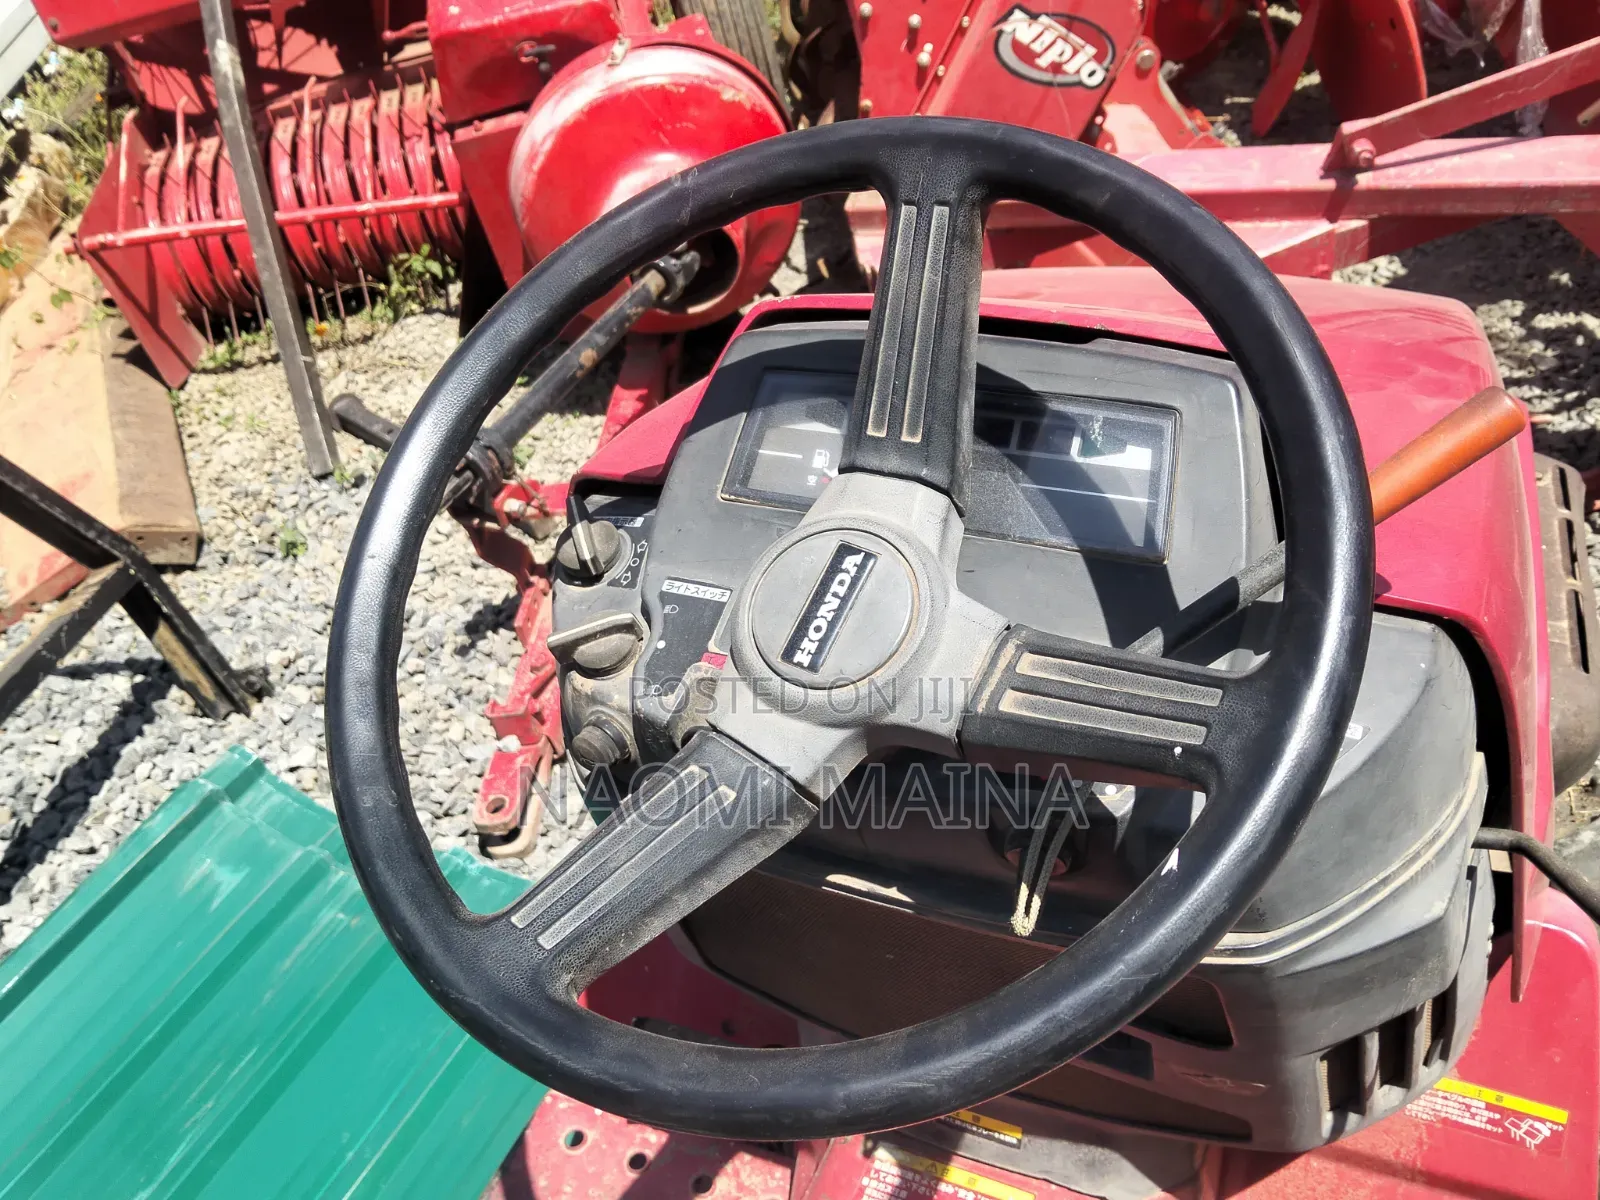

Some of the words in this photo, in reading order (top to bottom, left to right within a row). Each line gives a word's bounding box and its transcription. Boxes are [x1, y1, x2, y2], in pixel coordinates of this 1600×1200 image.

[1000, 8, 1106, 88] Niplo
[665, 581, 728, 600] ライトスイッチ
[793, 551, 866, 668] HONDA
